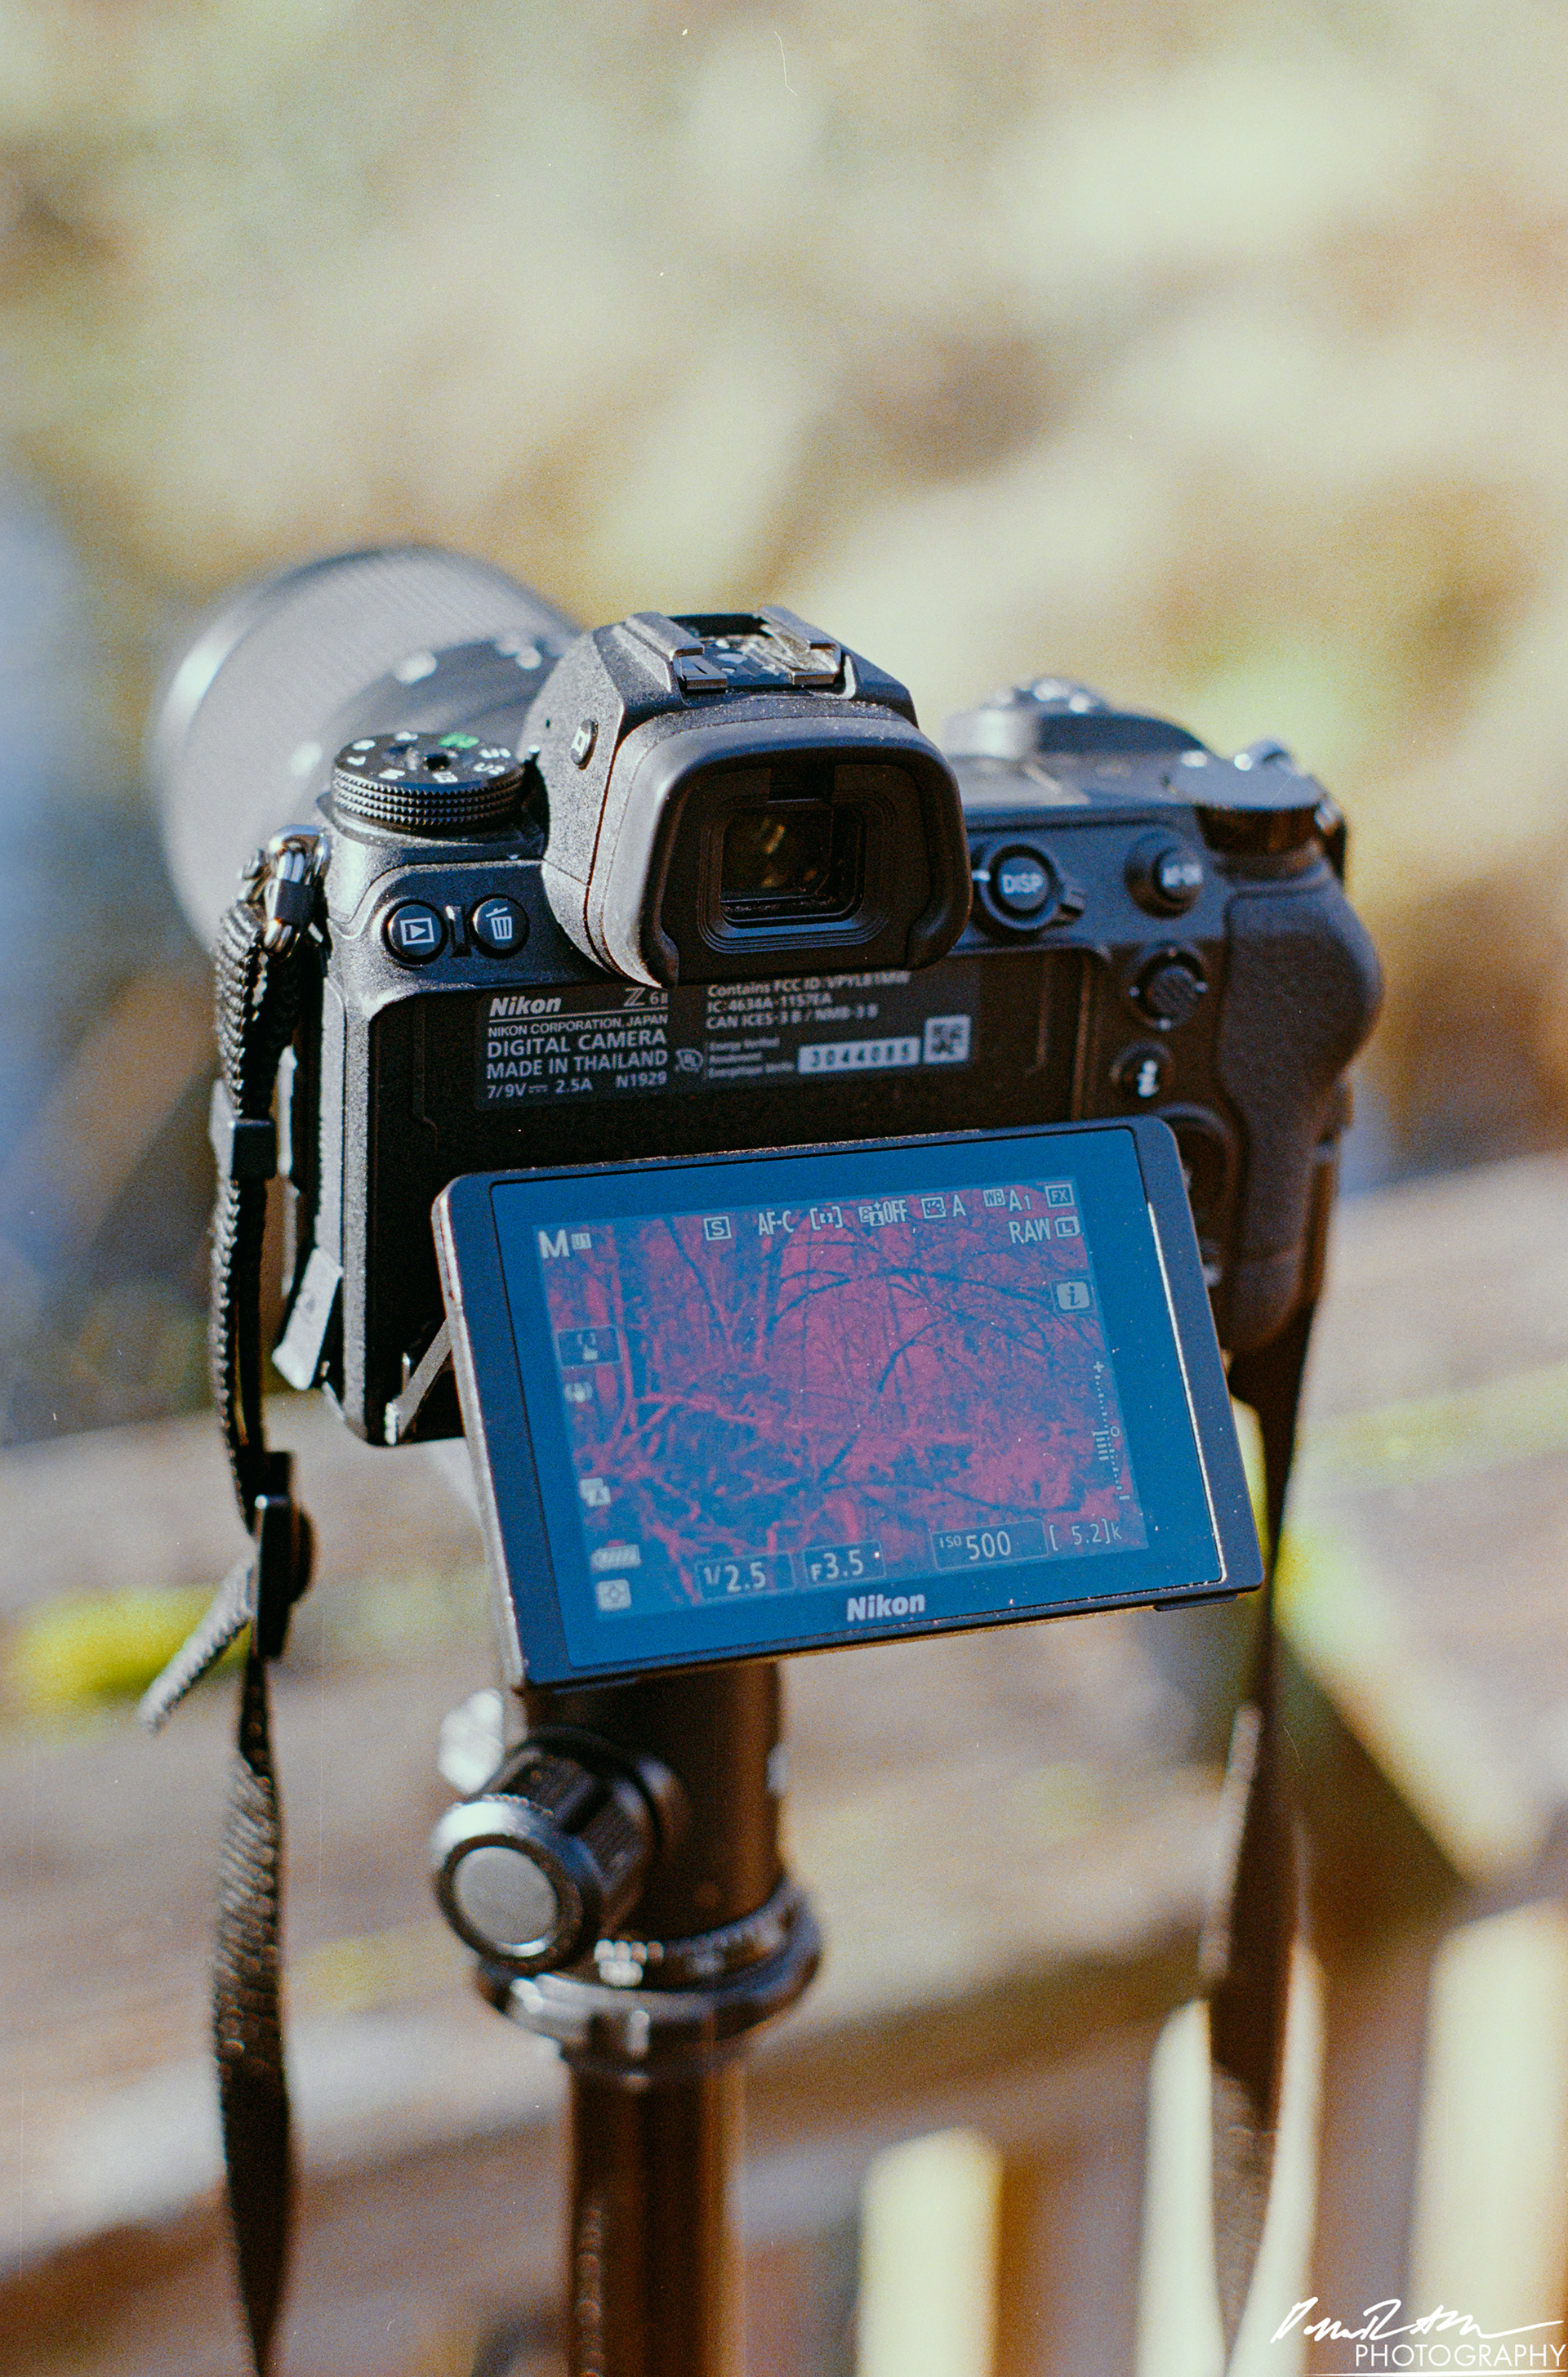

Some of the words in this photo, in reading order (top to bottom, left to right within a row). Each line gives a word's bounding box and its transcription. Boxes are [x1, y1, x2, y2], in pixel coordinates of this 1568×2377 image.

[1000, 872, 1044, 895] DISP
[707, 982, 771, 997] Contains
[773, 978, 801, 992] FCC
[489, 995, 562, 1017] Nikon
[488, 1023, 528, 1037] NIKON
[626, 1015, 669, 1028] JAPAN
[706, 1015, 738, 1030] CAN
[488, 1037, 571, 1059] DIGITAL
[577, 1028, 667, 1050] CAMERA
[486, 1059, 543, 1080] MADE
[548, 1057, 568, 1074] IN
[573, 1049, 669, 1072] THAILAND
[488, 1082, 528, 1099] 7/9V
[555, 1077, 594, 1094] 2.5A
[952, 1193, 967, 1217] A
[985, 1190, 1005, 1205] WB
[758, 1210, 795, 1236] AF-C
[884, 1199, 908, 1224] OFF
[537, 1228, 571, 1259] M
[1008, 1218, 1052, 1244] RAW
[938, 1535, 962, 1549] ISO
[966, 1530, 1012, 1561] 500
[810, 1550, 864, 1581] F3.5
[846, 1594, 925, 1622] Nikon
